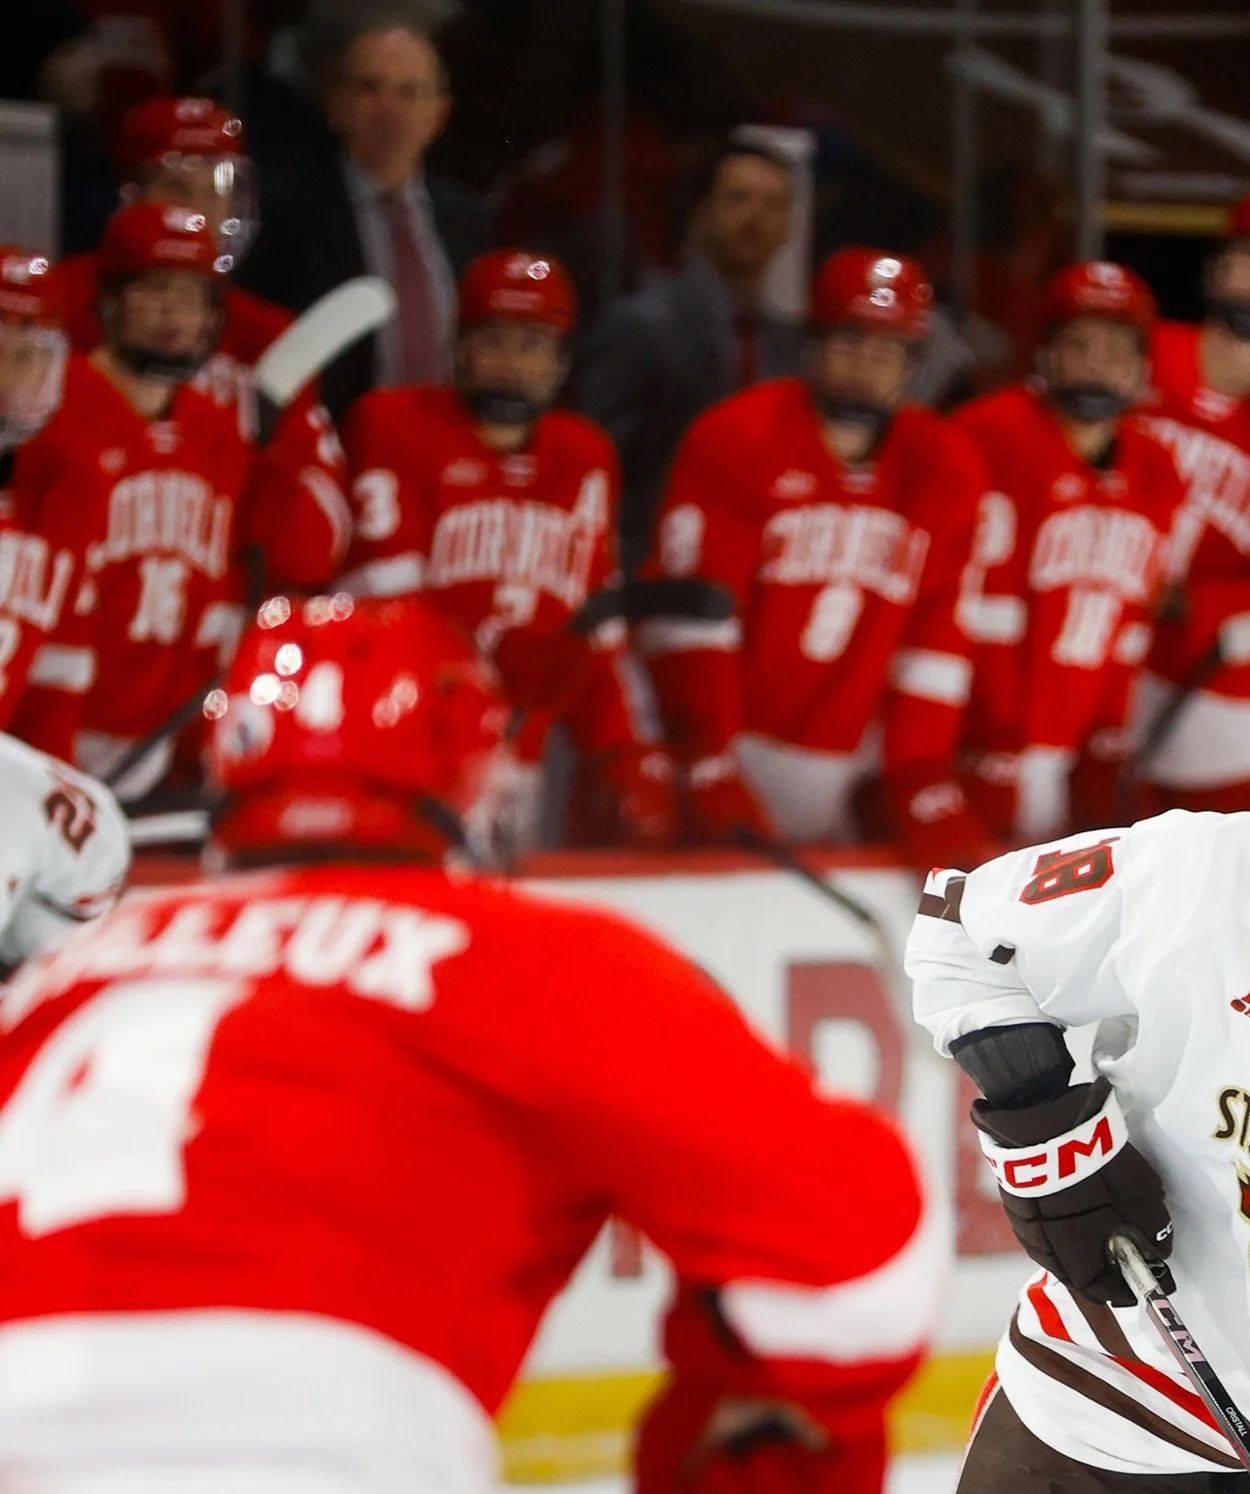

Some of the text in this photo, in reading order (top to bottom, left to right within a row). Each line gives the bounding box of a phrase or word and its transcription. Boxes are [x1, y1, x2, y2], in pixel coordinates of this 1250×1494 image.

[295, 660, 346, 734] 4
[43, 780, 97, 856] 2
[0, 972, 256, 1240] 4
[1156, 1222, 1174, 1242] CC
[1225, 1406, 1249, 1438] CRISTALL
